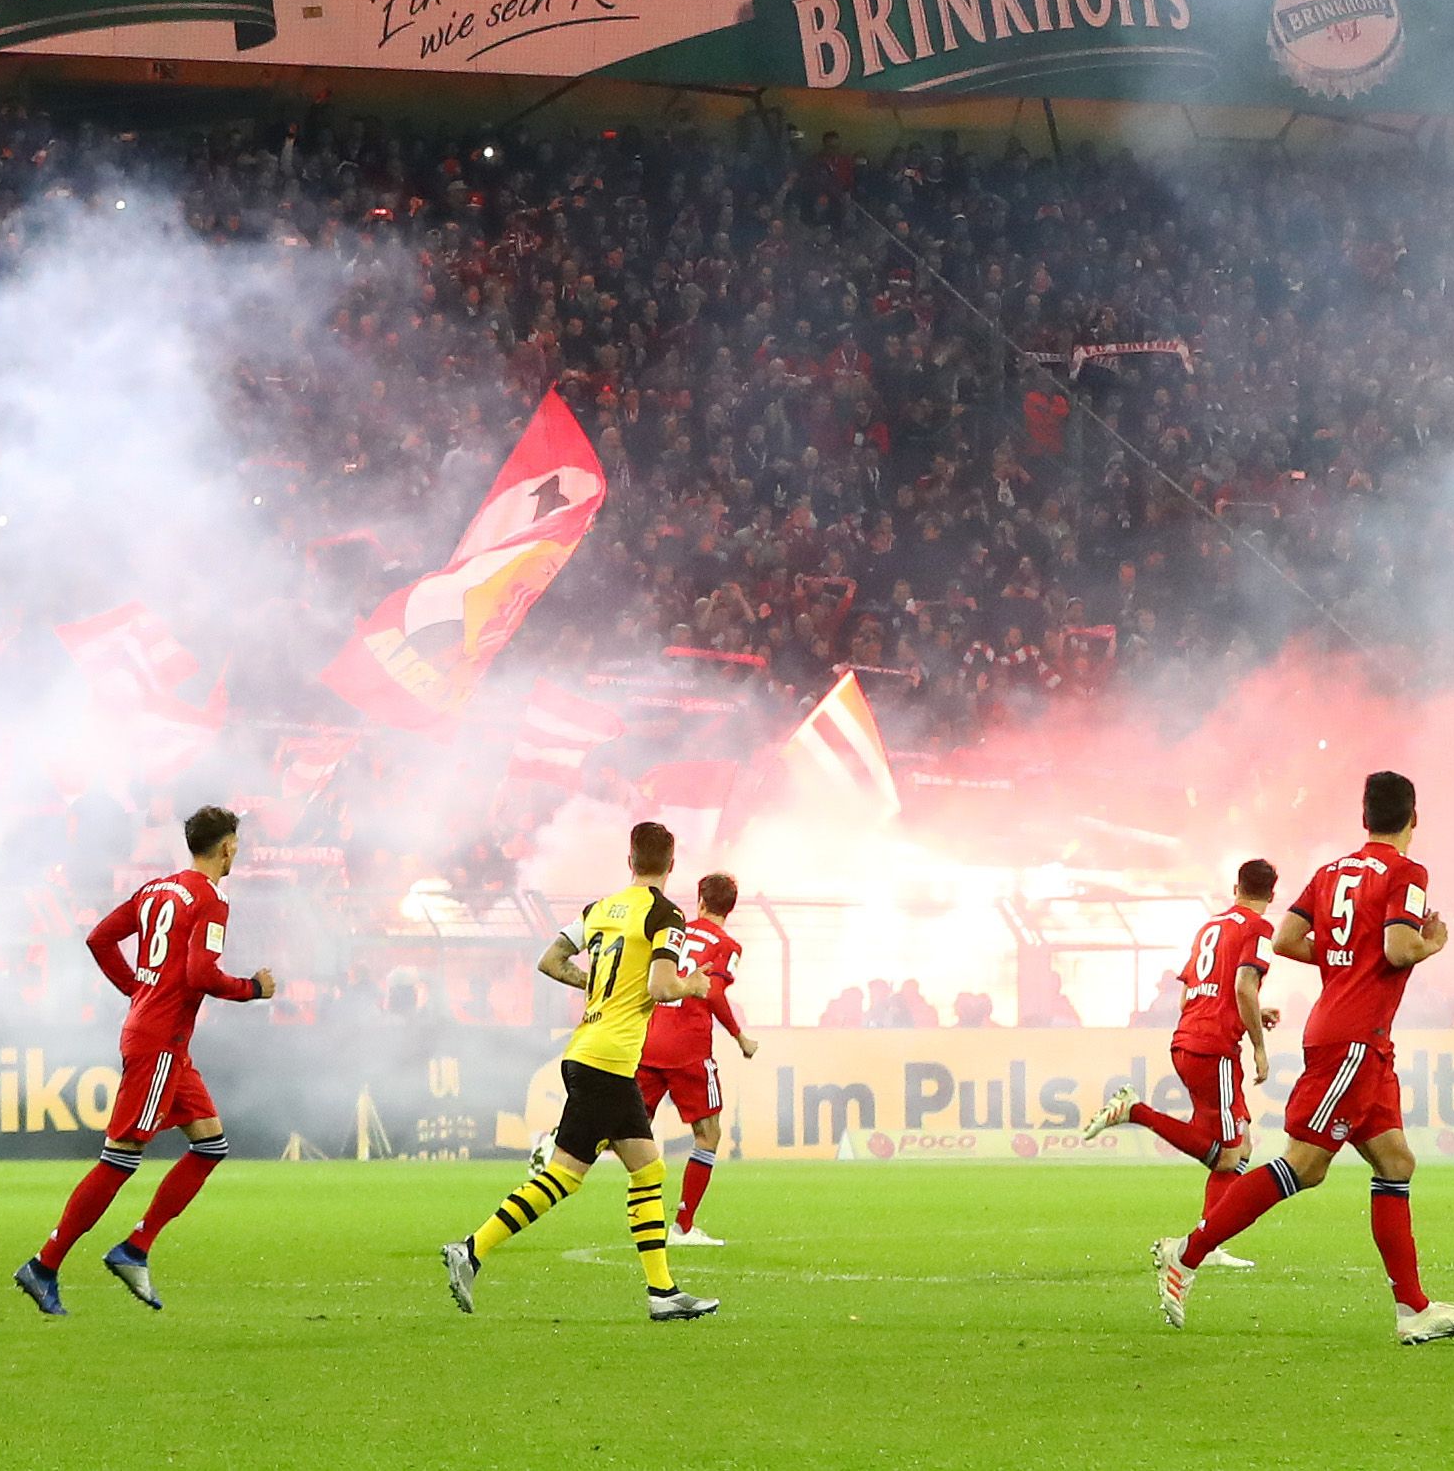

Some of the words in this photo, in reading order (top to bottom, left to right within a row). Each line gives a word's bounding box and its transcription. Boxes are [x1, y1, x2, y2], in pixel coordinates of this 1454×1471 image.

[420, 10, 475, 60] wie
[139, 896, 175, 968] 18
[1331, 873, 1364, 947] 5
[587, 930, 624, 1003] 11
[1195, 924, 1222, 982] 8
[777, 1065, 877, 1147] Im
[904, 1059, 1081, 1131] Puls
[1103, 1055, 1192, 1131] de
